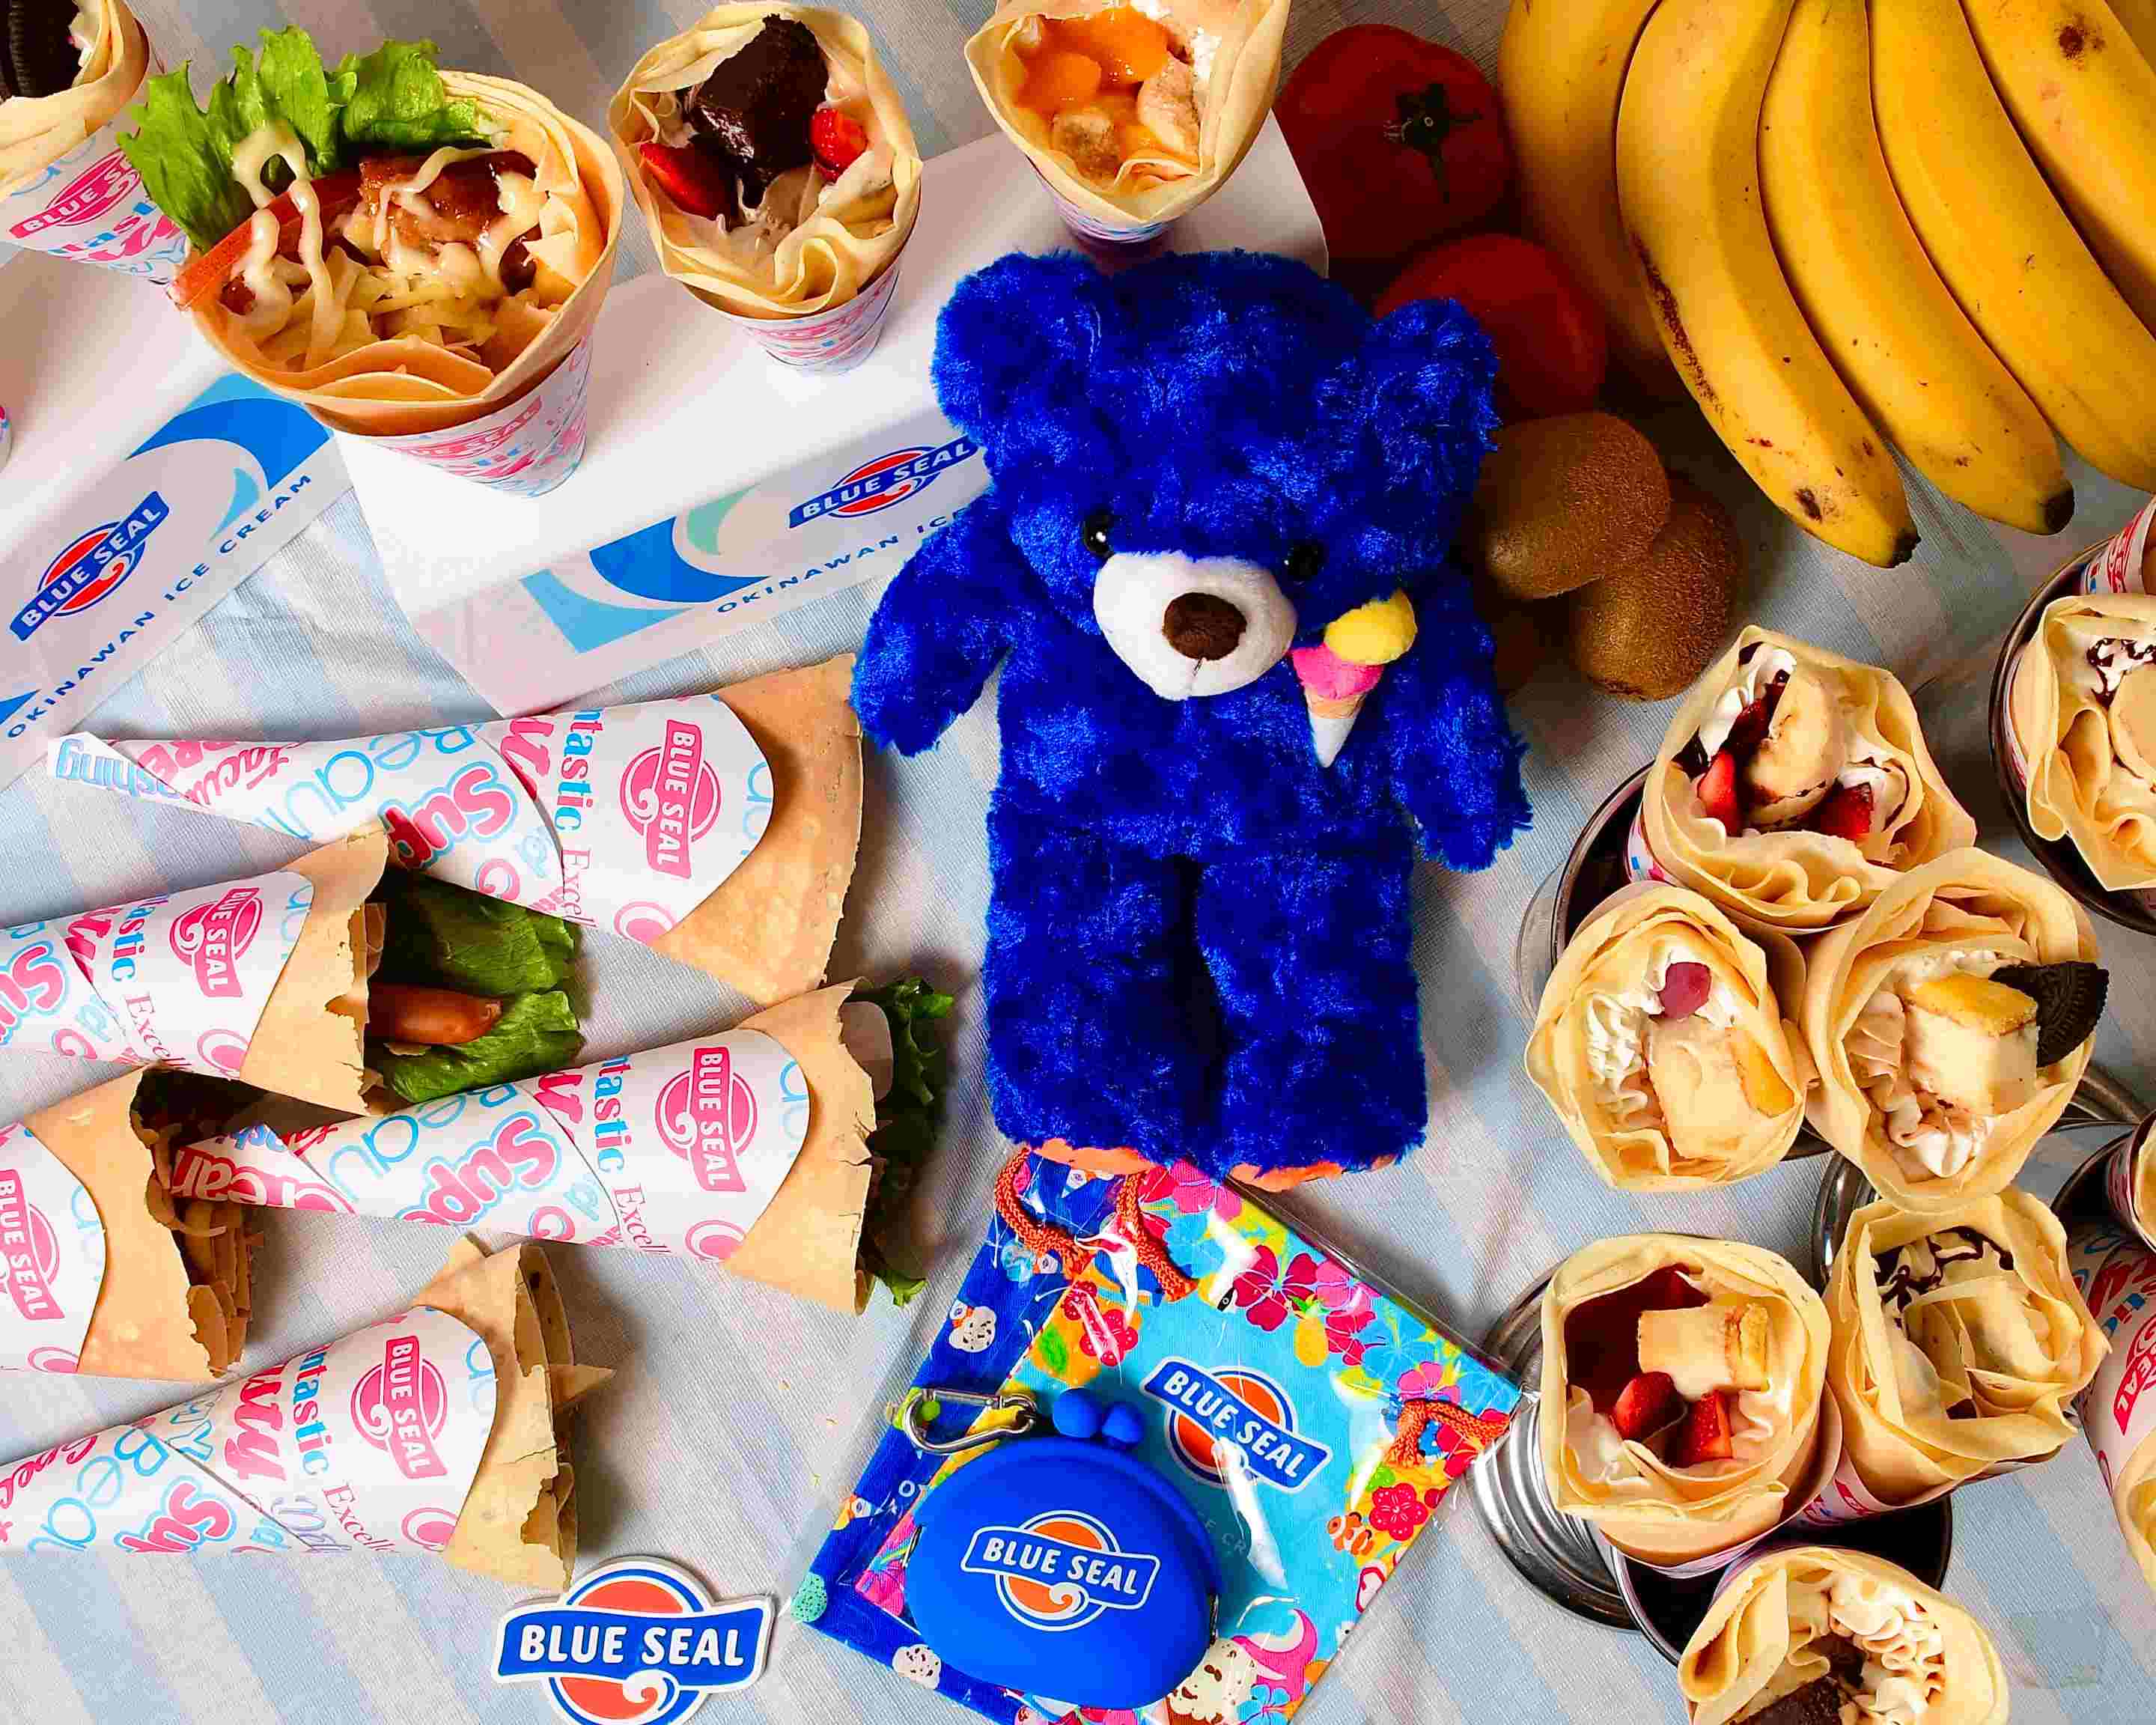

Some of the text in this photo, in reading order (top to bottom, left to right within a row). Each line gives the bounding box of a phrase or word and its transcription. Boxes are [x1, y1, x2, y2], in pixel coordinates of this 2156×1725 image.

[22, 186, 98, 232] BLUE
[803, 444, 970, 520] BLUE SEAL
[7, 475, 311, 738] OKINAWAN ICE CREAM
[22, 505, 162, 630] BLUE SEAL
[718, 535, 899, 613] OKINAWAN
[657, 731, 694, 865] BLUE SEAL
[205, 928, 228, 991] SEAL
[699, 1051, 730, 1185] BLUE SEAL
[10, 1254, 49, 1315] SEAL
[389, 1342, 430, 1473] BLUE SEAL
[1166, 1372, 1305, 1479] BLUE SEAL
[983, 1539, 1139, 1593] BLUE SEAL
[520, 1625, 743, 1667] BLUE SEAL
